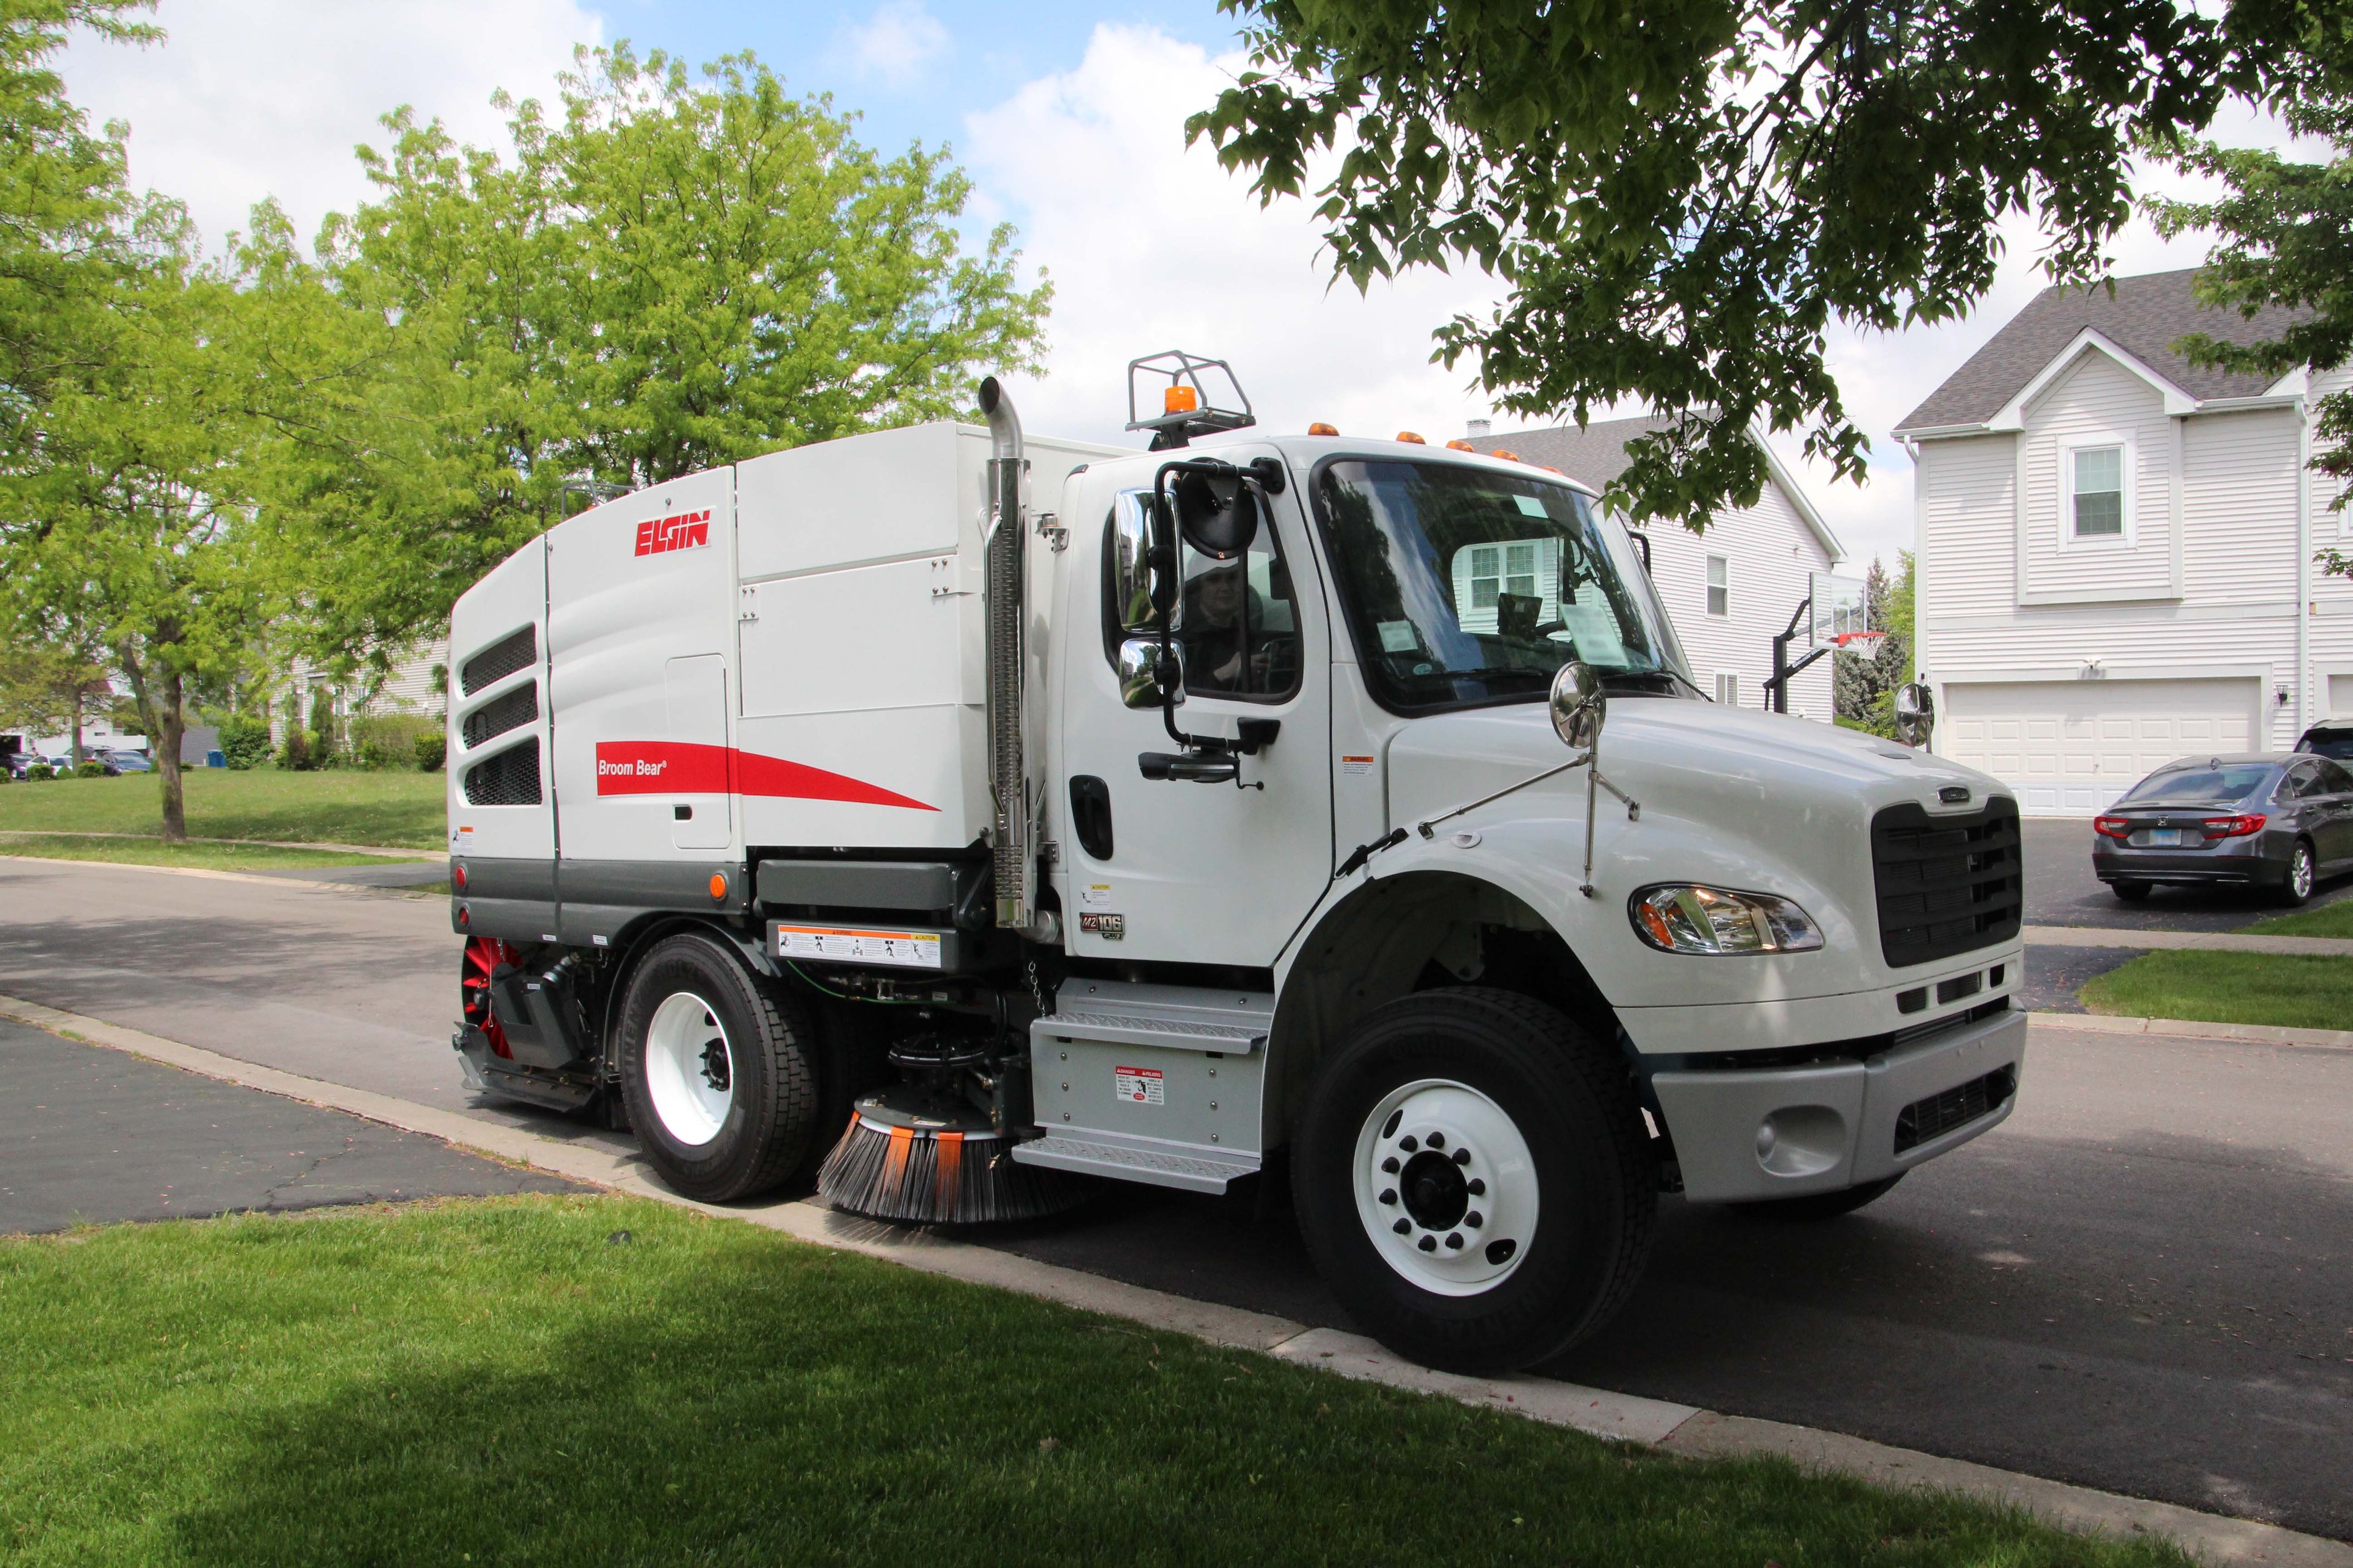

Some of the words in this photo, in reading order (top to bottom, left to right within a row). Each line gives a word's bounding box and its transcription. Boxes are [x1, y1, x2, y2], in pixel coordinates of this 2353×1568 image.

[635, 510, 710, 557] ELGIN
[599, 759, 634, 775] Broom
[1082, 917, 1096, 928] M2
[1098, 915, 1122, 931] 106
